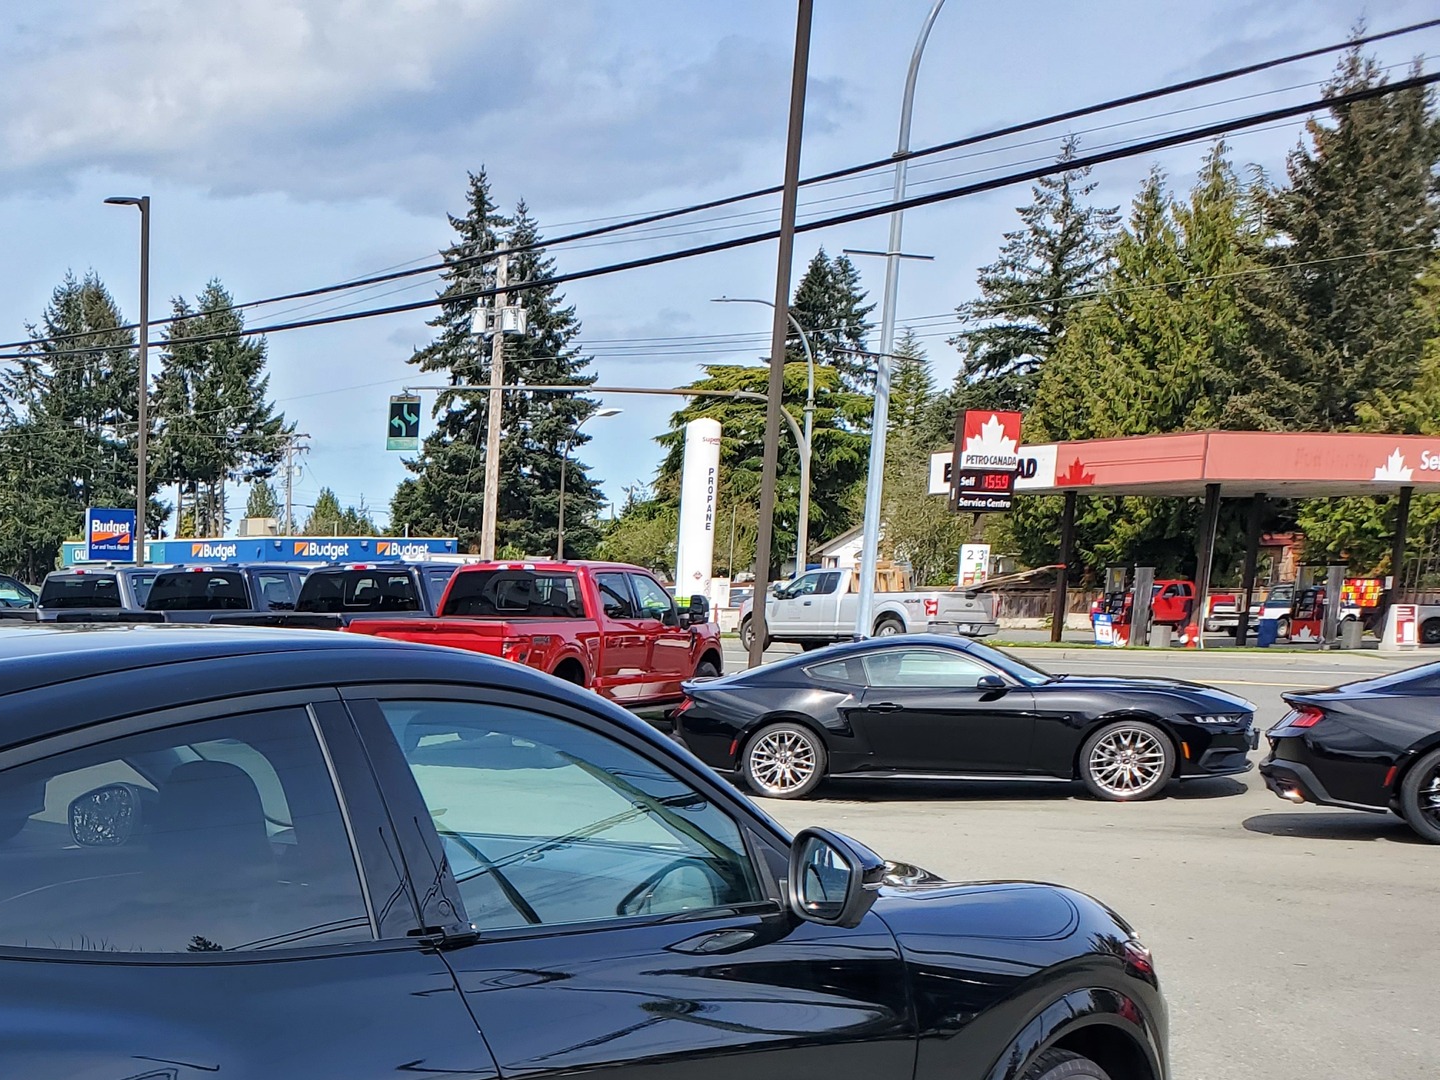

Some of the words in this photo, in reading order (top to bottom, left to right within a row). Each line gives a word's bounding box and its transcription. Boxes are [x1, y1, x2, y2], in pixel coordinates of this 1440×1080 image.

[960, 476, 976, 486] Self
[705, 467, 715, 530] PROPANE
[958, 497, 986, 508] Service
[987, 499, 1011, 508] Centre
[92, 520, 131, 536] Budget
[204, 543, 237, 558] Budget
[309, 542, 349, 558] Budget
[392, 542, 429, 557] Budget
